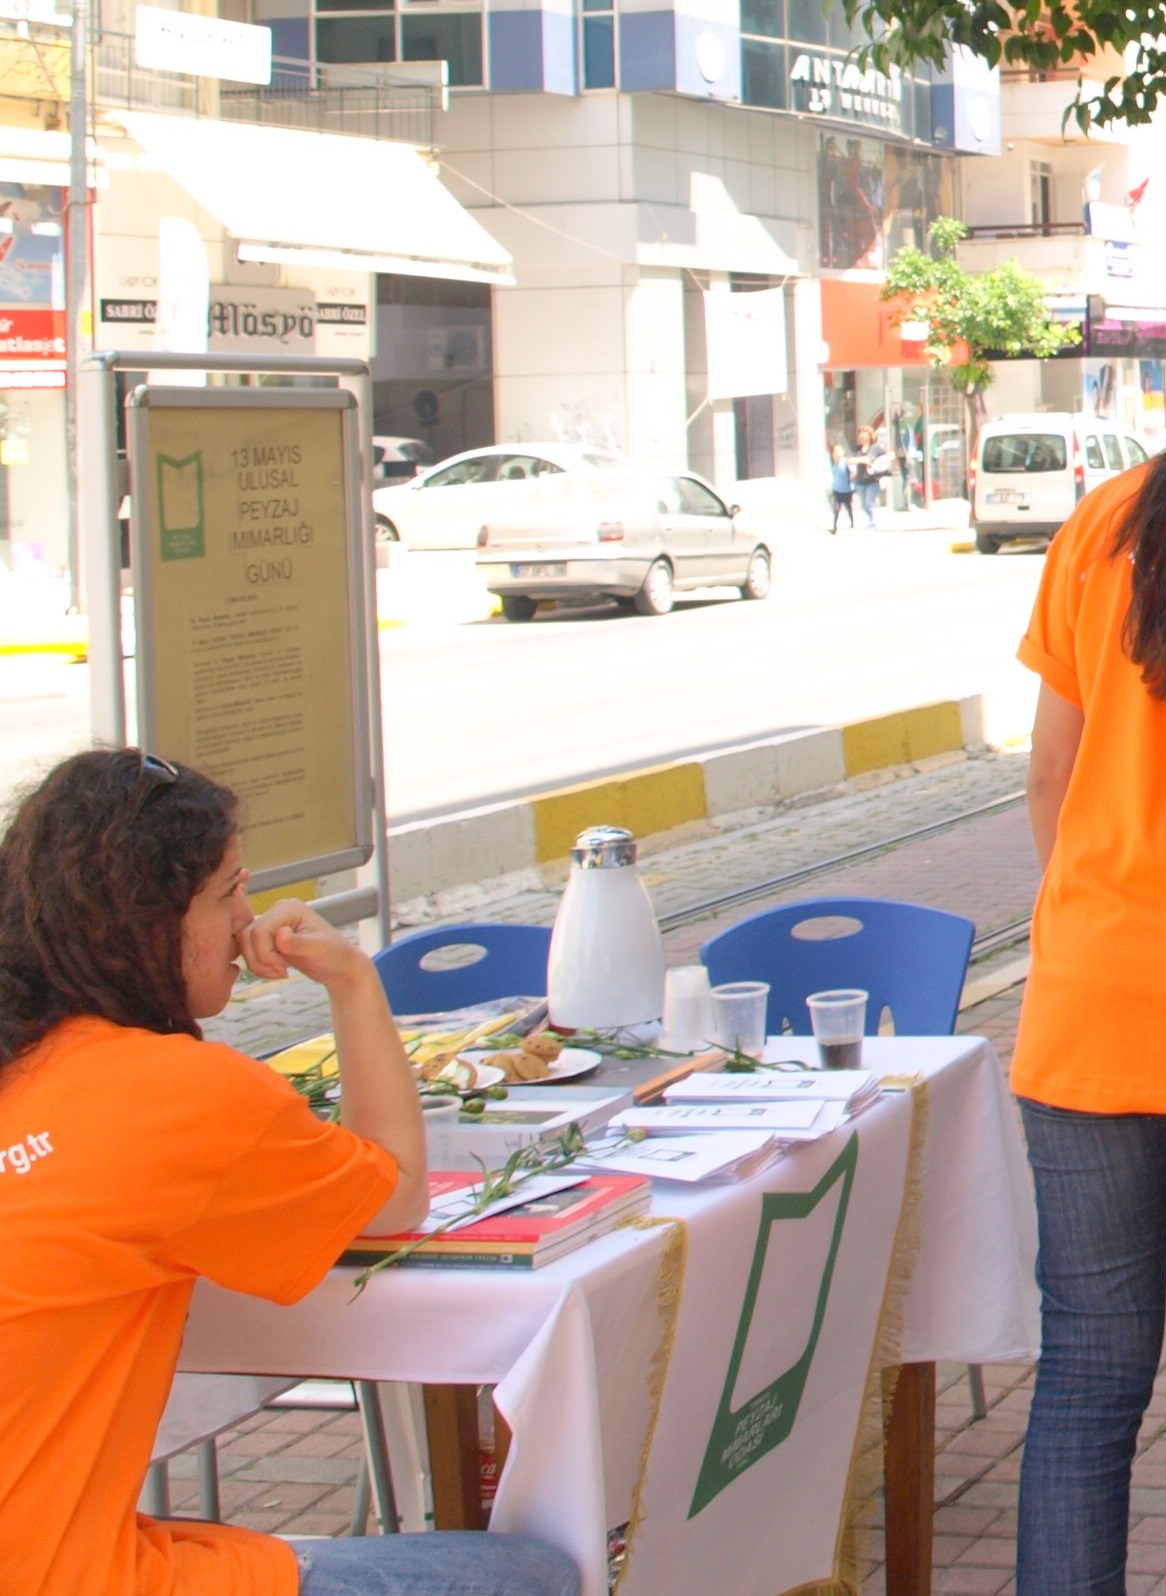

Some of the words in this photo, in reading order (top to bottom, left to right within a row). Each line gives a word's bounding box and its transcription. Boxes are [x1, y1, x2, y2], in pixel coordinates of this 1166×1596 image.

[207, 301, 313, 345] Mösyö
[231, 448, 249, 468] 13
[253, 445, 302, 467] MAYIS
[239, 468, 299, 491] ULUSAL
[240, 498, 299, 520] PEYZAJ
[247, 557, 293, 584] GÜNÜ
[0, 1131, 54, 1175] rg.tr
